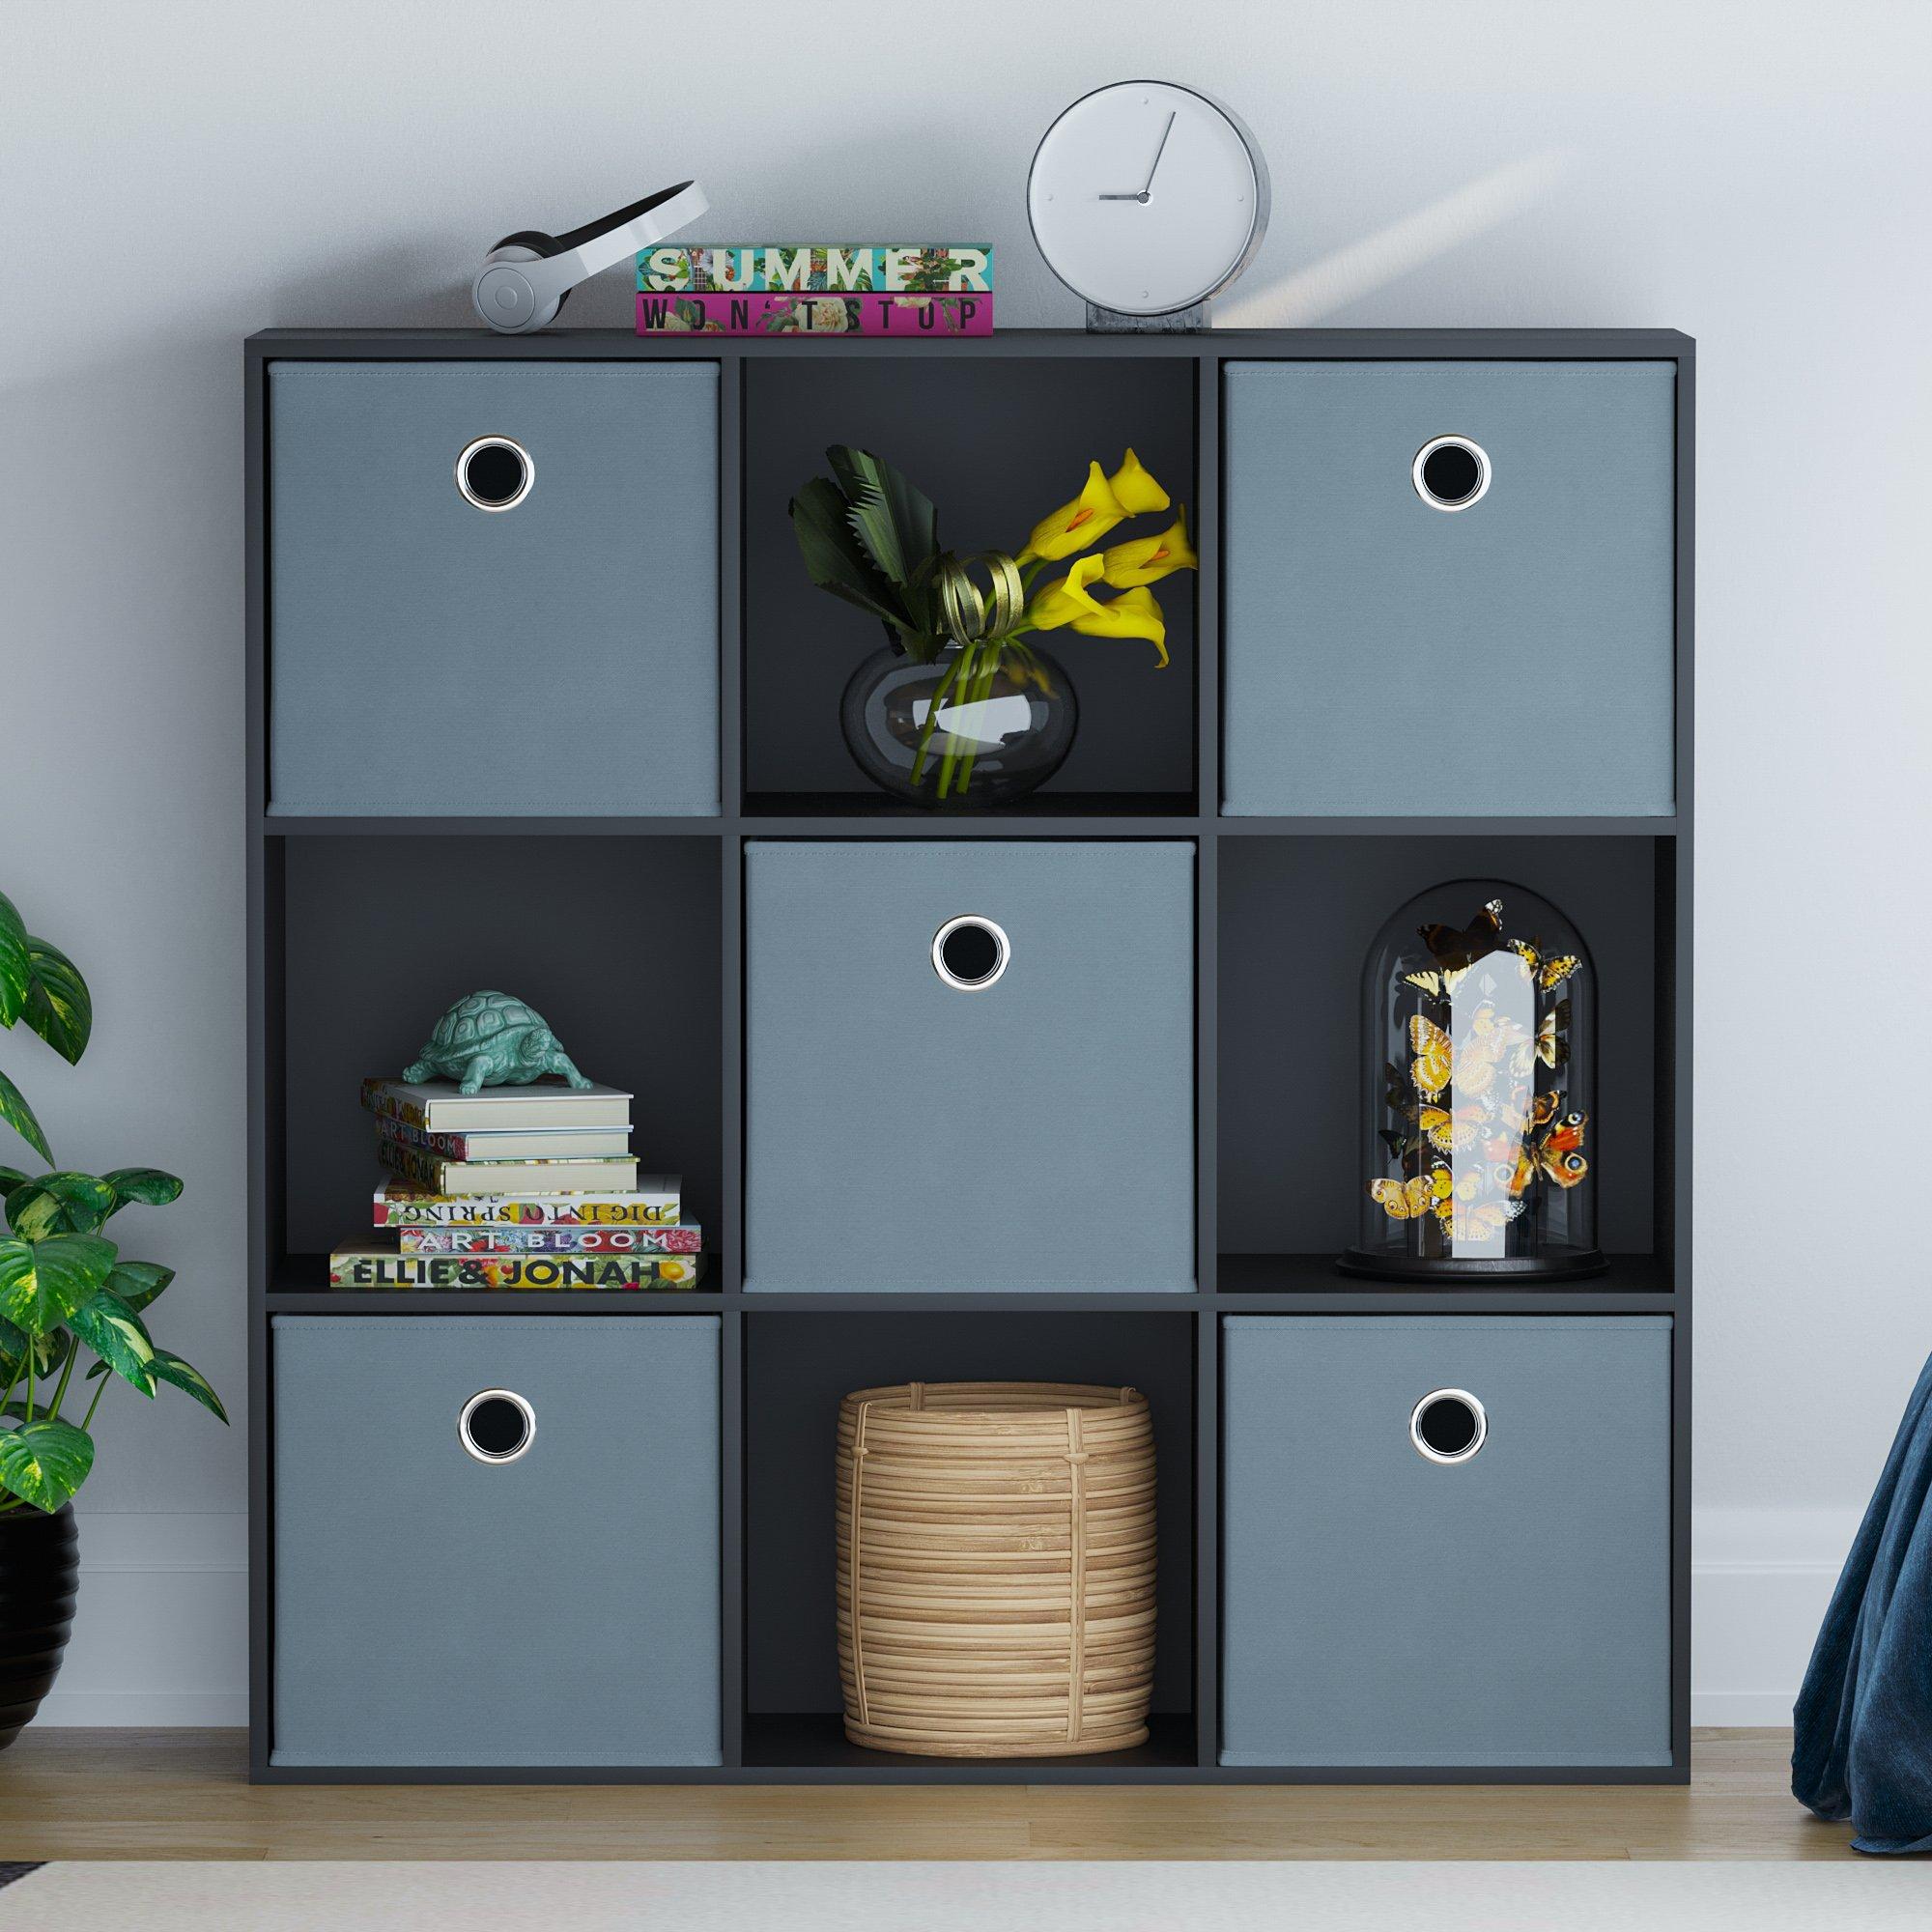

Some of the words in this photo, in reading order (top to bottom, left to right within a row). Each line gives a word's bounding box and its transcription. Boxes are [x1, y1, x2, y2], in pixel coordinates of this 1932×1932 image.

[649, 248, 990, 291] SUMMER
[845, 299, 976, 330] STOP
[380, 1120, 405, 1141] ART
[412, 1129, 456, 1154] BLOOM
[404, 1206, 511, 1222] SPRING
[525, 1206, 598, 1222] INTO
[611, 1206, 662, 1222] DIG
[417, 1233, 501, 1249] ART
[527, 1233, 671, 1251] BLOOM
[503, 1260, 661, 1285] JONAH
